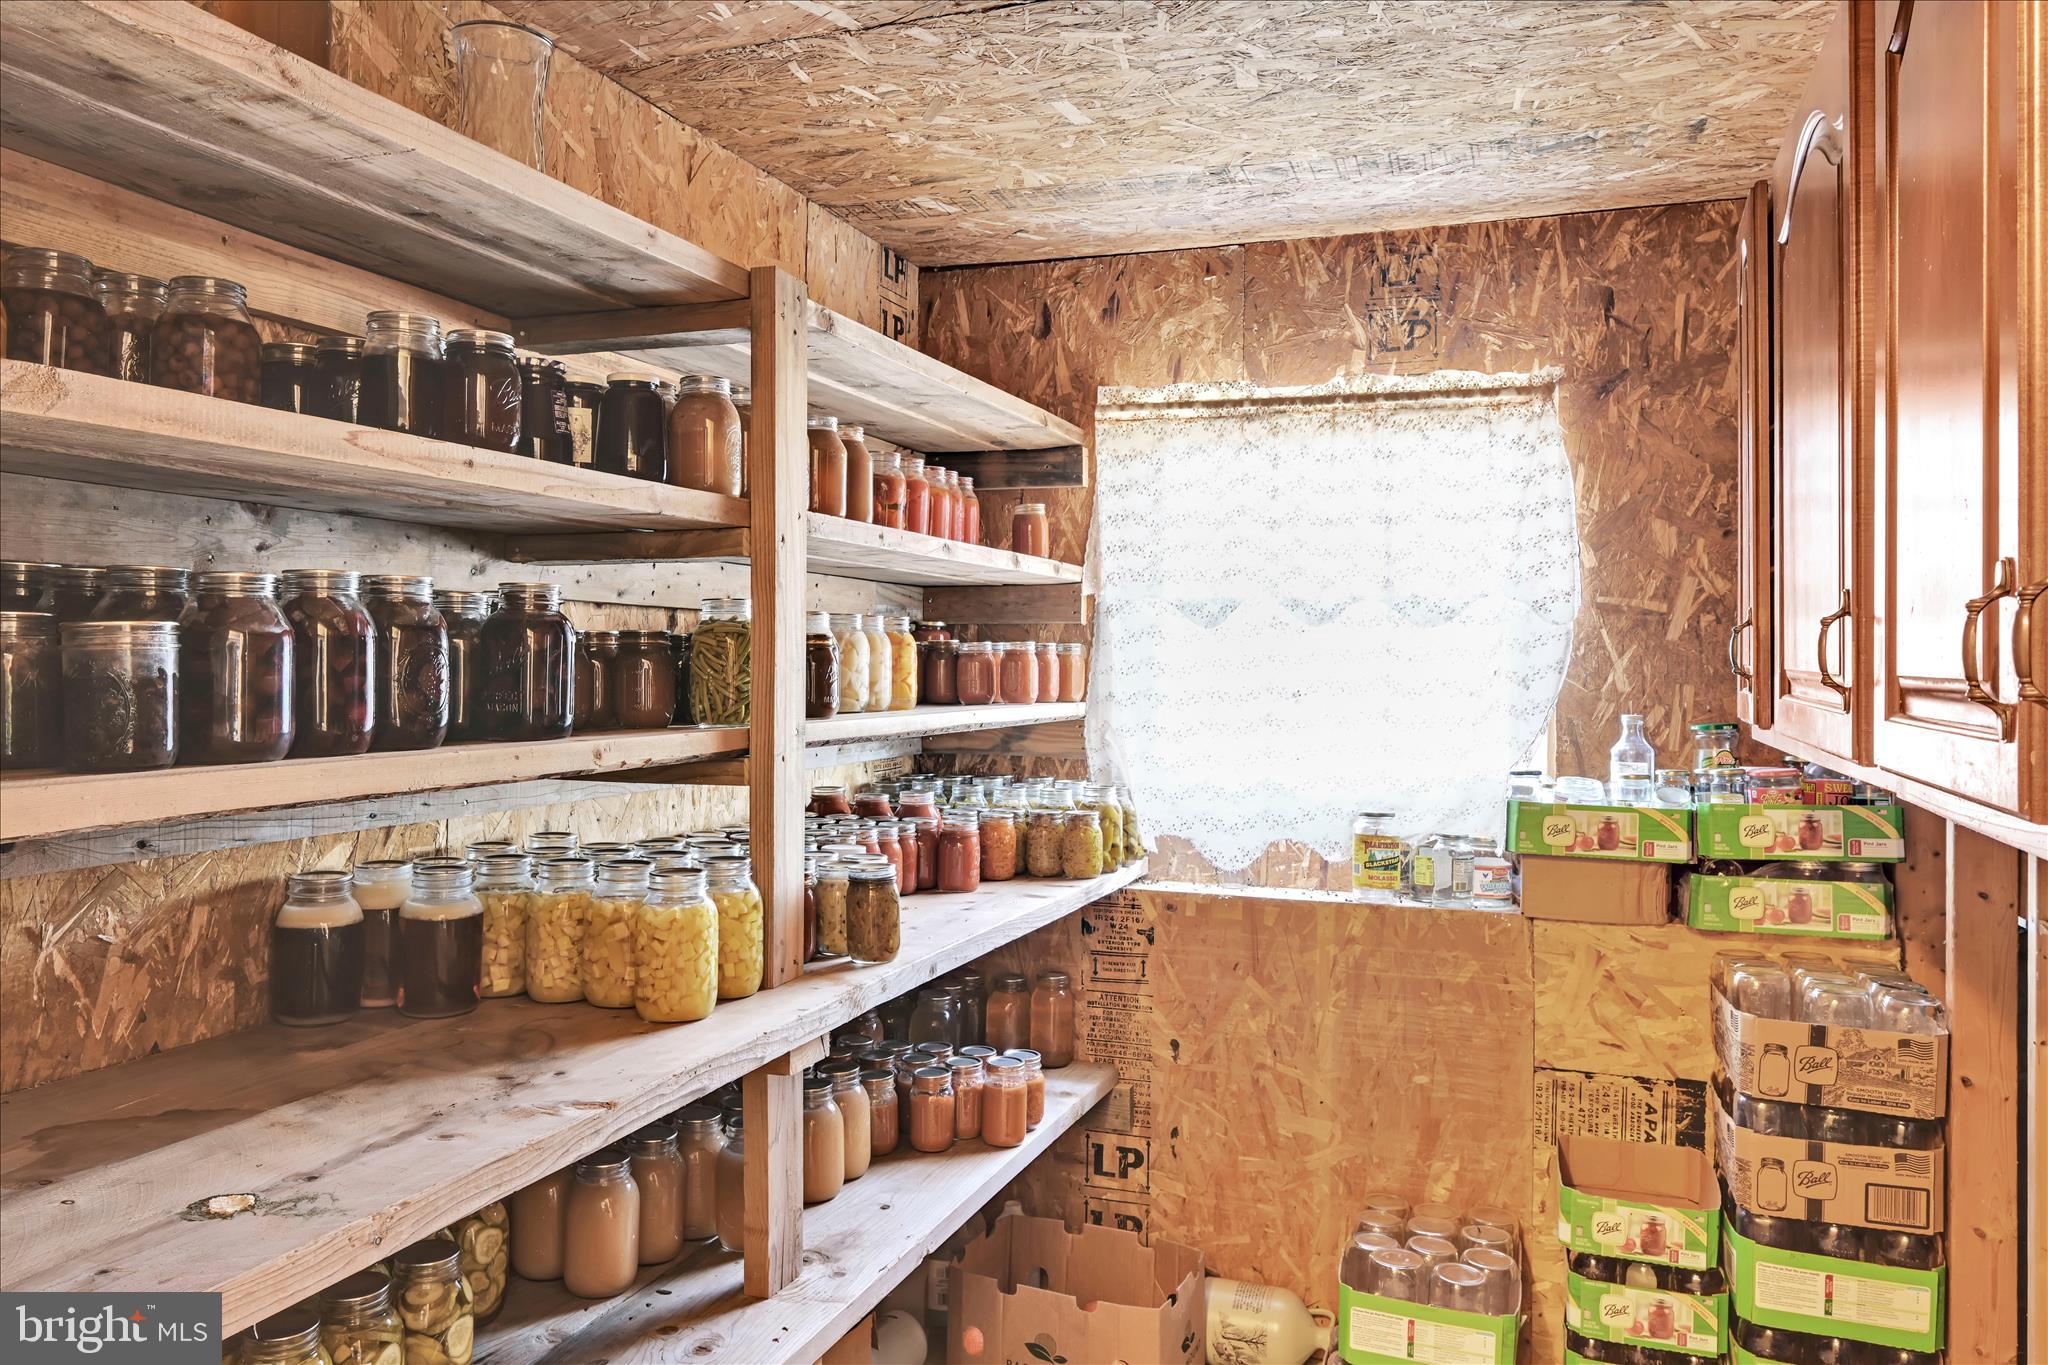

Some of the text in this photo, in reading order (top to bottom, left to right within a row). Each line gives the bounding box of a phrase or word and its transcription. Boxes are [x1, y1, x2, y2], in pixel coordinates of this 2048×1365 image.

[1547, 824, 1570, 838] Ball
[1744, 824, 1769, 839] Ball
[1734, 896, 1759, 910] Ball
[1099, 994, 1139, 1003] ATTENTION
[1799, 1056, 1832, 1074] Ball
[1602, 1086, 1610, 1113] 24/16
[1644, 1102, 1658, 1143] APA
[1092, 1142, 1144, 1179] LP
[1798, 1171, 1832, 1188] Ball
[1597, 1221, 1622, 1235] Ball
[1604, 1304, 1630, 1318] Ball
